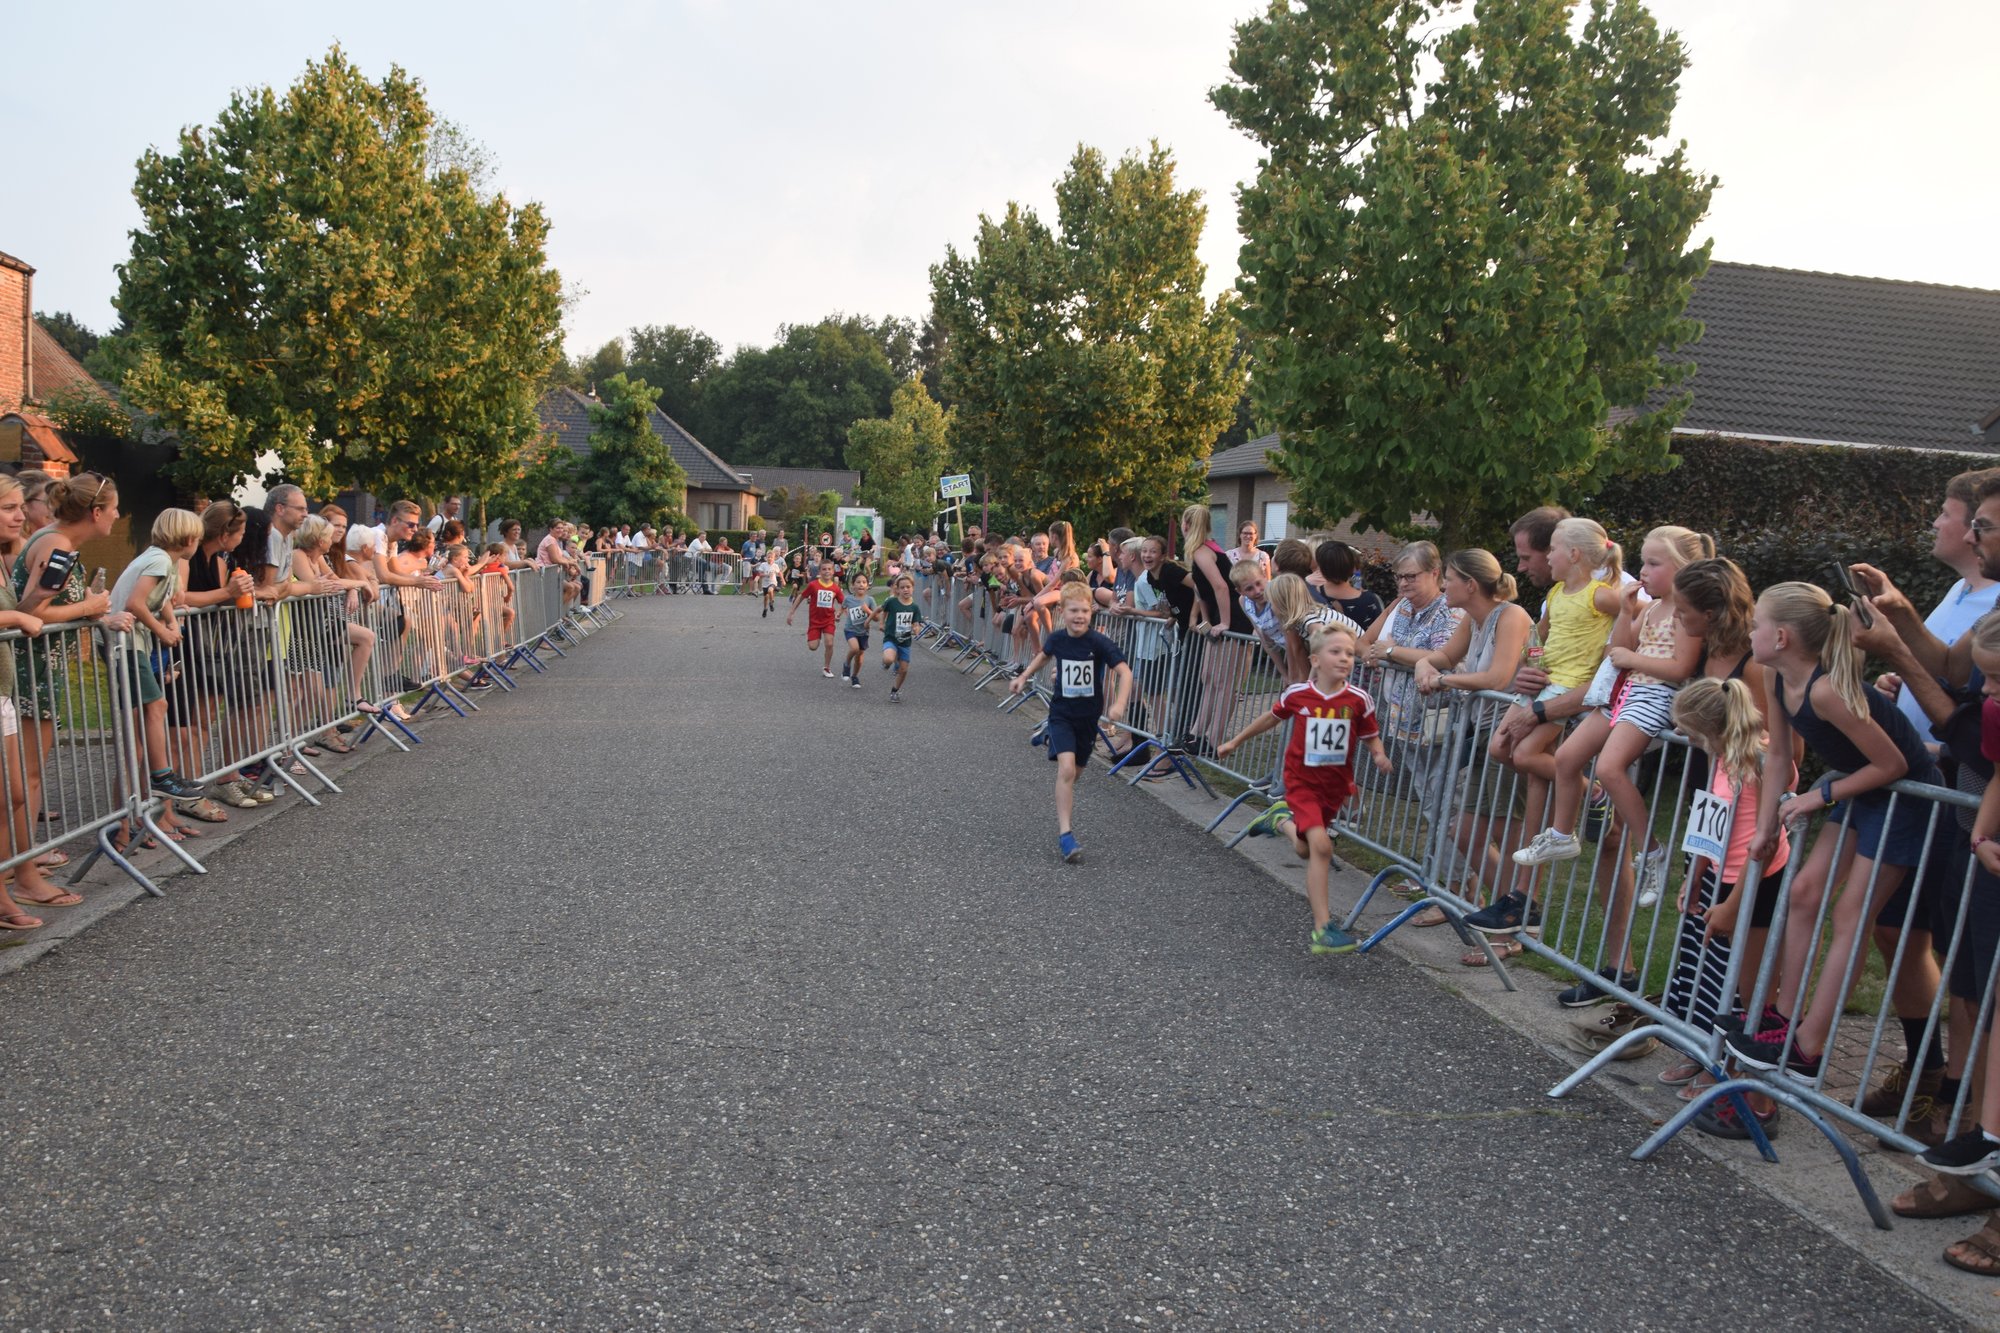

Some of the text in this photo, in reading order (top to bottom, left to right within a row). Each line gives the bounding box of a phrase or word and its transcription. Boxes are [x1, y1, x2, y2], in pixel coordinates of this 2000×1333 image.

[943, 480, 969, 493] START
[819, 591, 832, 602] 125
[851, 607, 866, 619] 133
[897, 611, 912, 625] 144
[1065, 664, 1092, 686] 126
[1311, 722, 1346, 750] 142
[1697, 797, 1728, 842] 170
